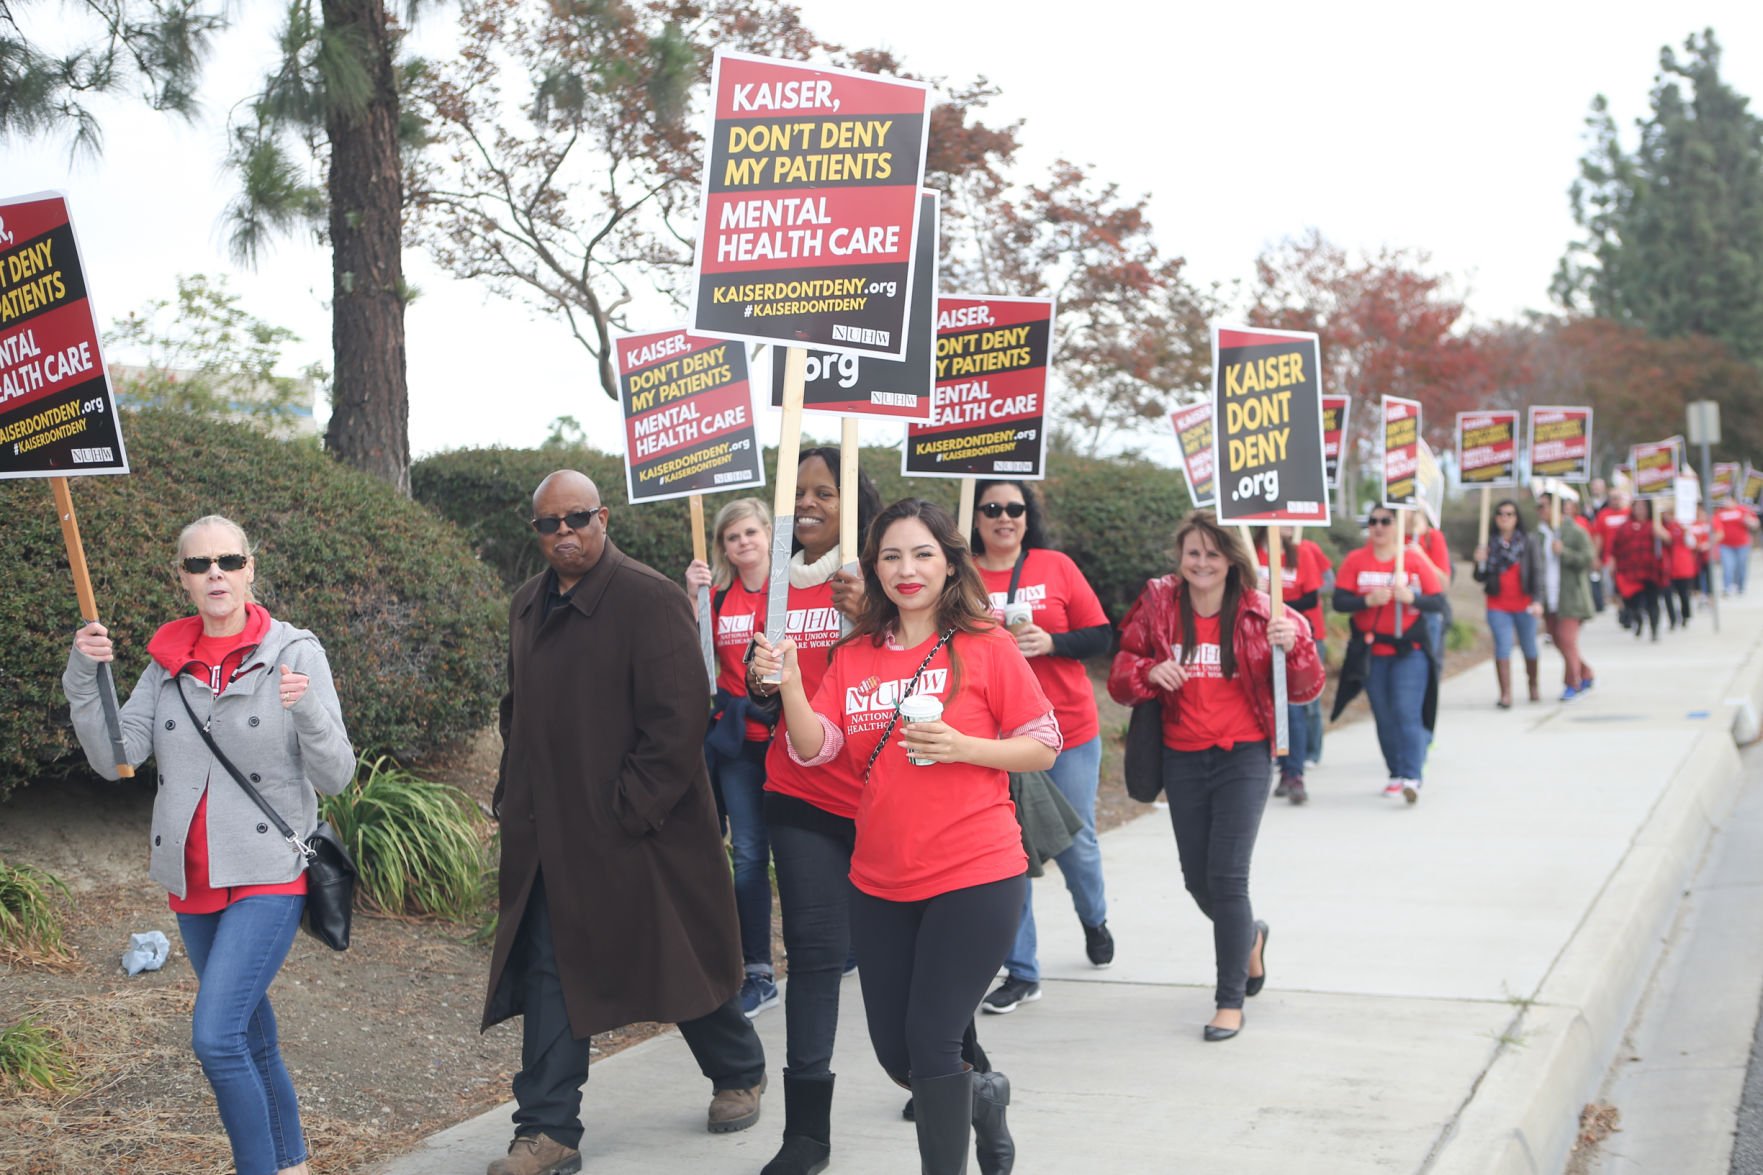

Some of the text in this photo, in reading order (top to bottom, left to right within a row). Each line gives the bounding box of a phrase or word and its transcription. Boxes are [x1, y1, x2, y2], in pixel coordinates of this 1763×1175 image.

[733, 80, 840, 112] KAISER,
[728, 121, 893, 153] DON'T DENY
[724, 152, 892, 186] MY PATIENTS
[720, 197, 832, 229] MENTAL
[717, 226, 900, 262] HEALTH CARE
[8, 238, 53, 283] DENY
[0, 271, 66, 322] ATIENTS
[713, 278, 897, 304] KAISERDONTDENY.org
[744, 298, 867, 317] #KAISERDONTDENY
[937, 305, 995, 330] AISER,
[0, 329, 41, 369] NTAL
[626, 334, 692, 368] KAISER,
[832, 325, 890, 347] NUHW
[937, 326, 1031, 357] ON'T DENY
[0, 341, 93, 403] ALTH CARE
[682, 346, 727, 376] DENY
[936, 347, 1031, 378] Y PATIENTS
[1225, 352, 1306, 398] KAISER
[631, 365, 732, 413] MY PATIENTS
[871, 391, 917, 407] NUHW
[936, 380, 991, 406] ENTAL
[0, 397, 104, 445] AISERDONTDENY.org
[634, 402, 700, 439] MENTAL
[917, 393, 1037, 429] EALTH CARE
[1226, 391, 1292, 435] DONT
[14, 418, 87, 455] #KAISERDONTDENY
[636, 406, 746, 458] HEALTH CARE
[916, 429, 1037, 455] KAISERDONTDENY.org
[71, 447, 114, 463] NUHW
[639, 439, 750, 482] KAISERDONTDENY.org
[1228, 427, 1291, 472] DENY
[1231, 470, 1280, 502] .org
[718, 614, 755, 634] NU
[786, 608, 840, 633] UH
[847, 721, 889, 736] HEALTHC
[851, 711, 893, 725] NATIONA
